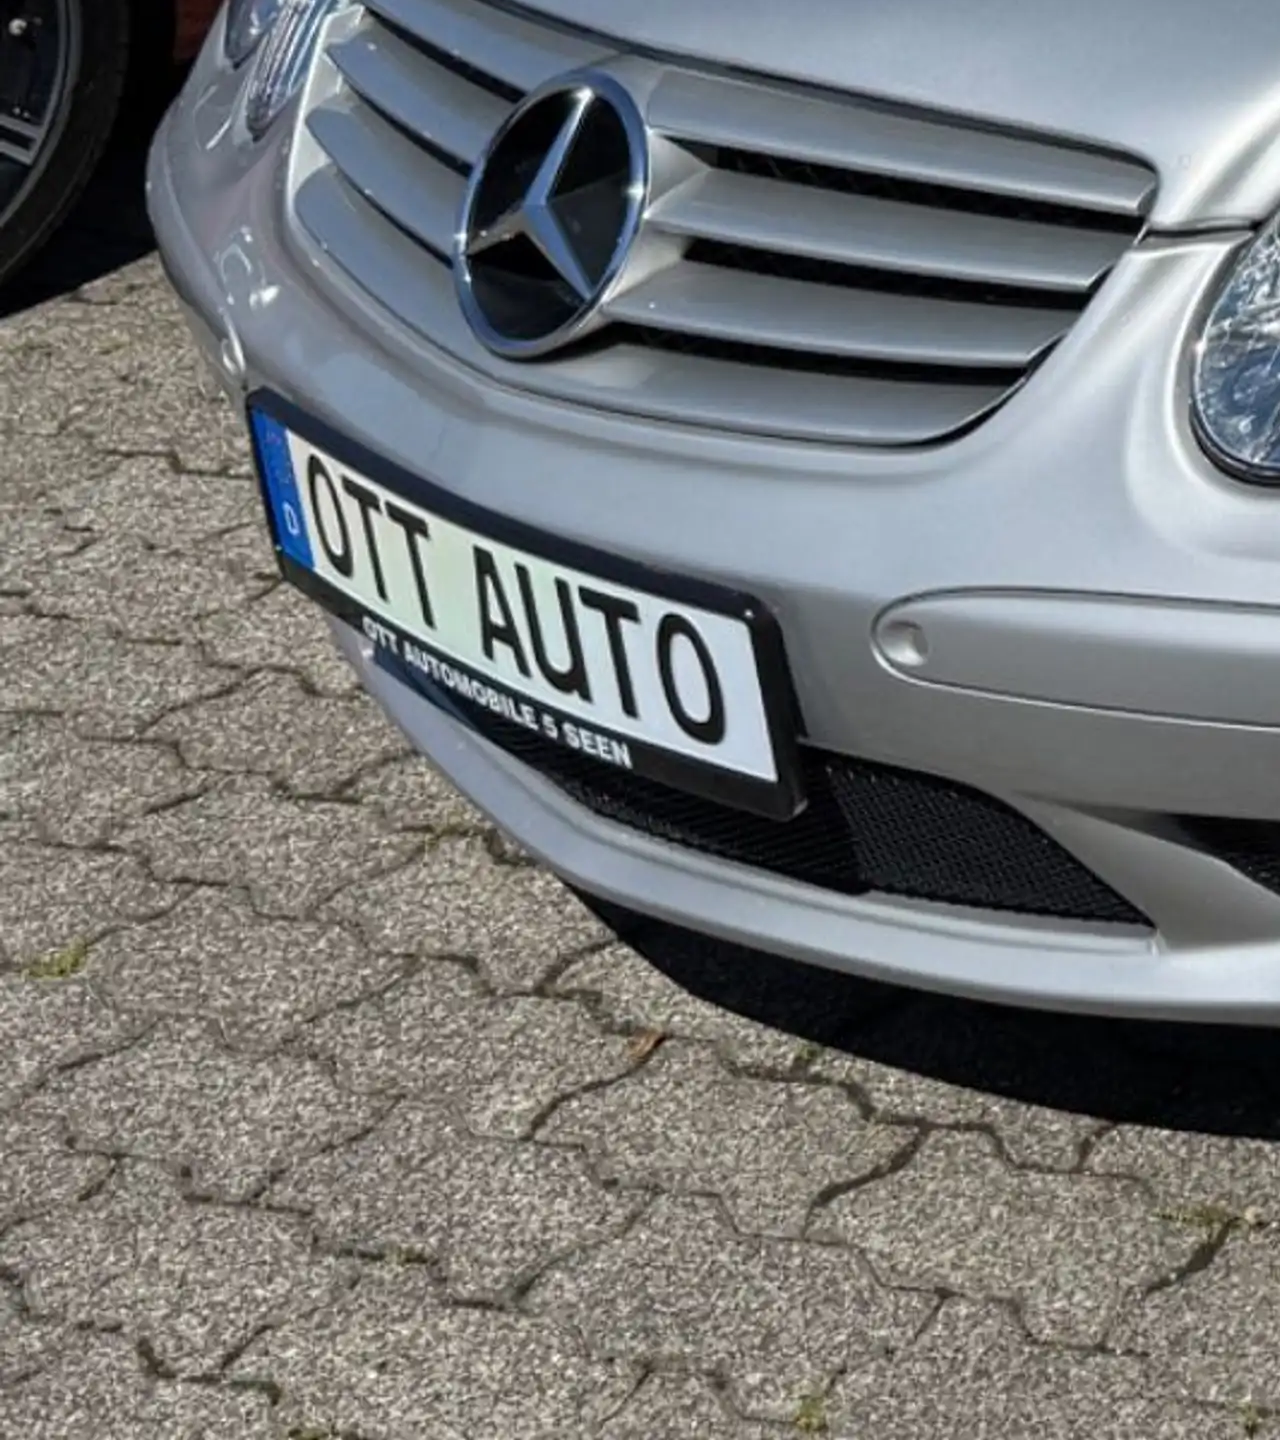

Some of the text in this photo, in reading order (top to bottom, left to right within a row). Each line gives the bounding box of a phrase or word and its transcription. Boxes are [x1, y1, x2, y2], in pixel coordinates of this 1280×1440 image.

[307, 453, 726, 745] OTT AUTO
[362, 615, 399, 655] OTT
[403, 640, 539, 731] AUTOMOBILE
[561, 721, 633, 770] SEEN
